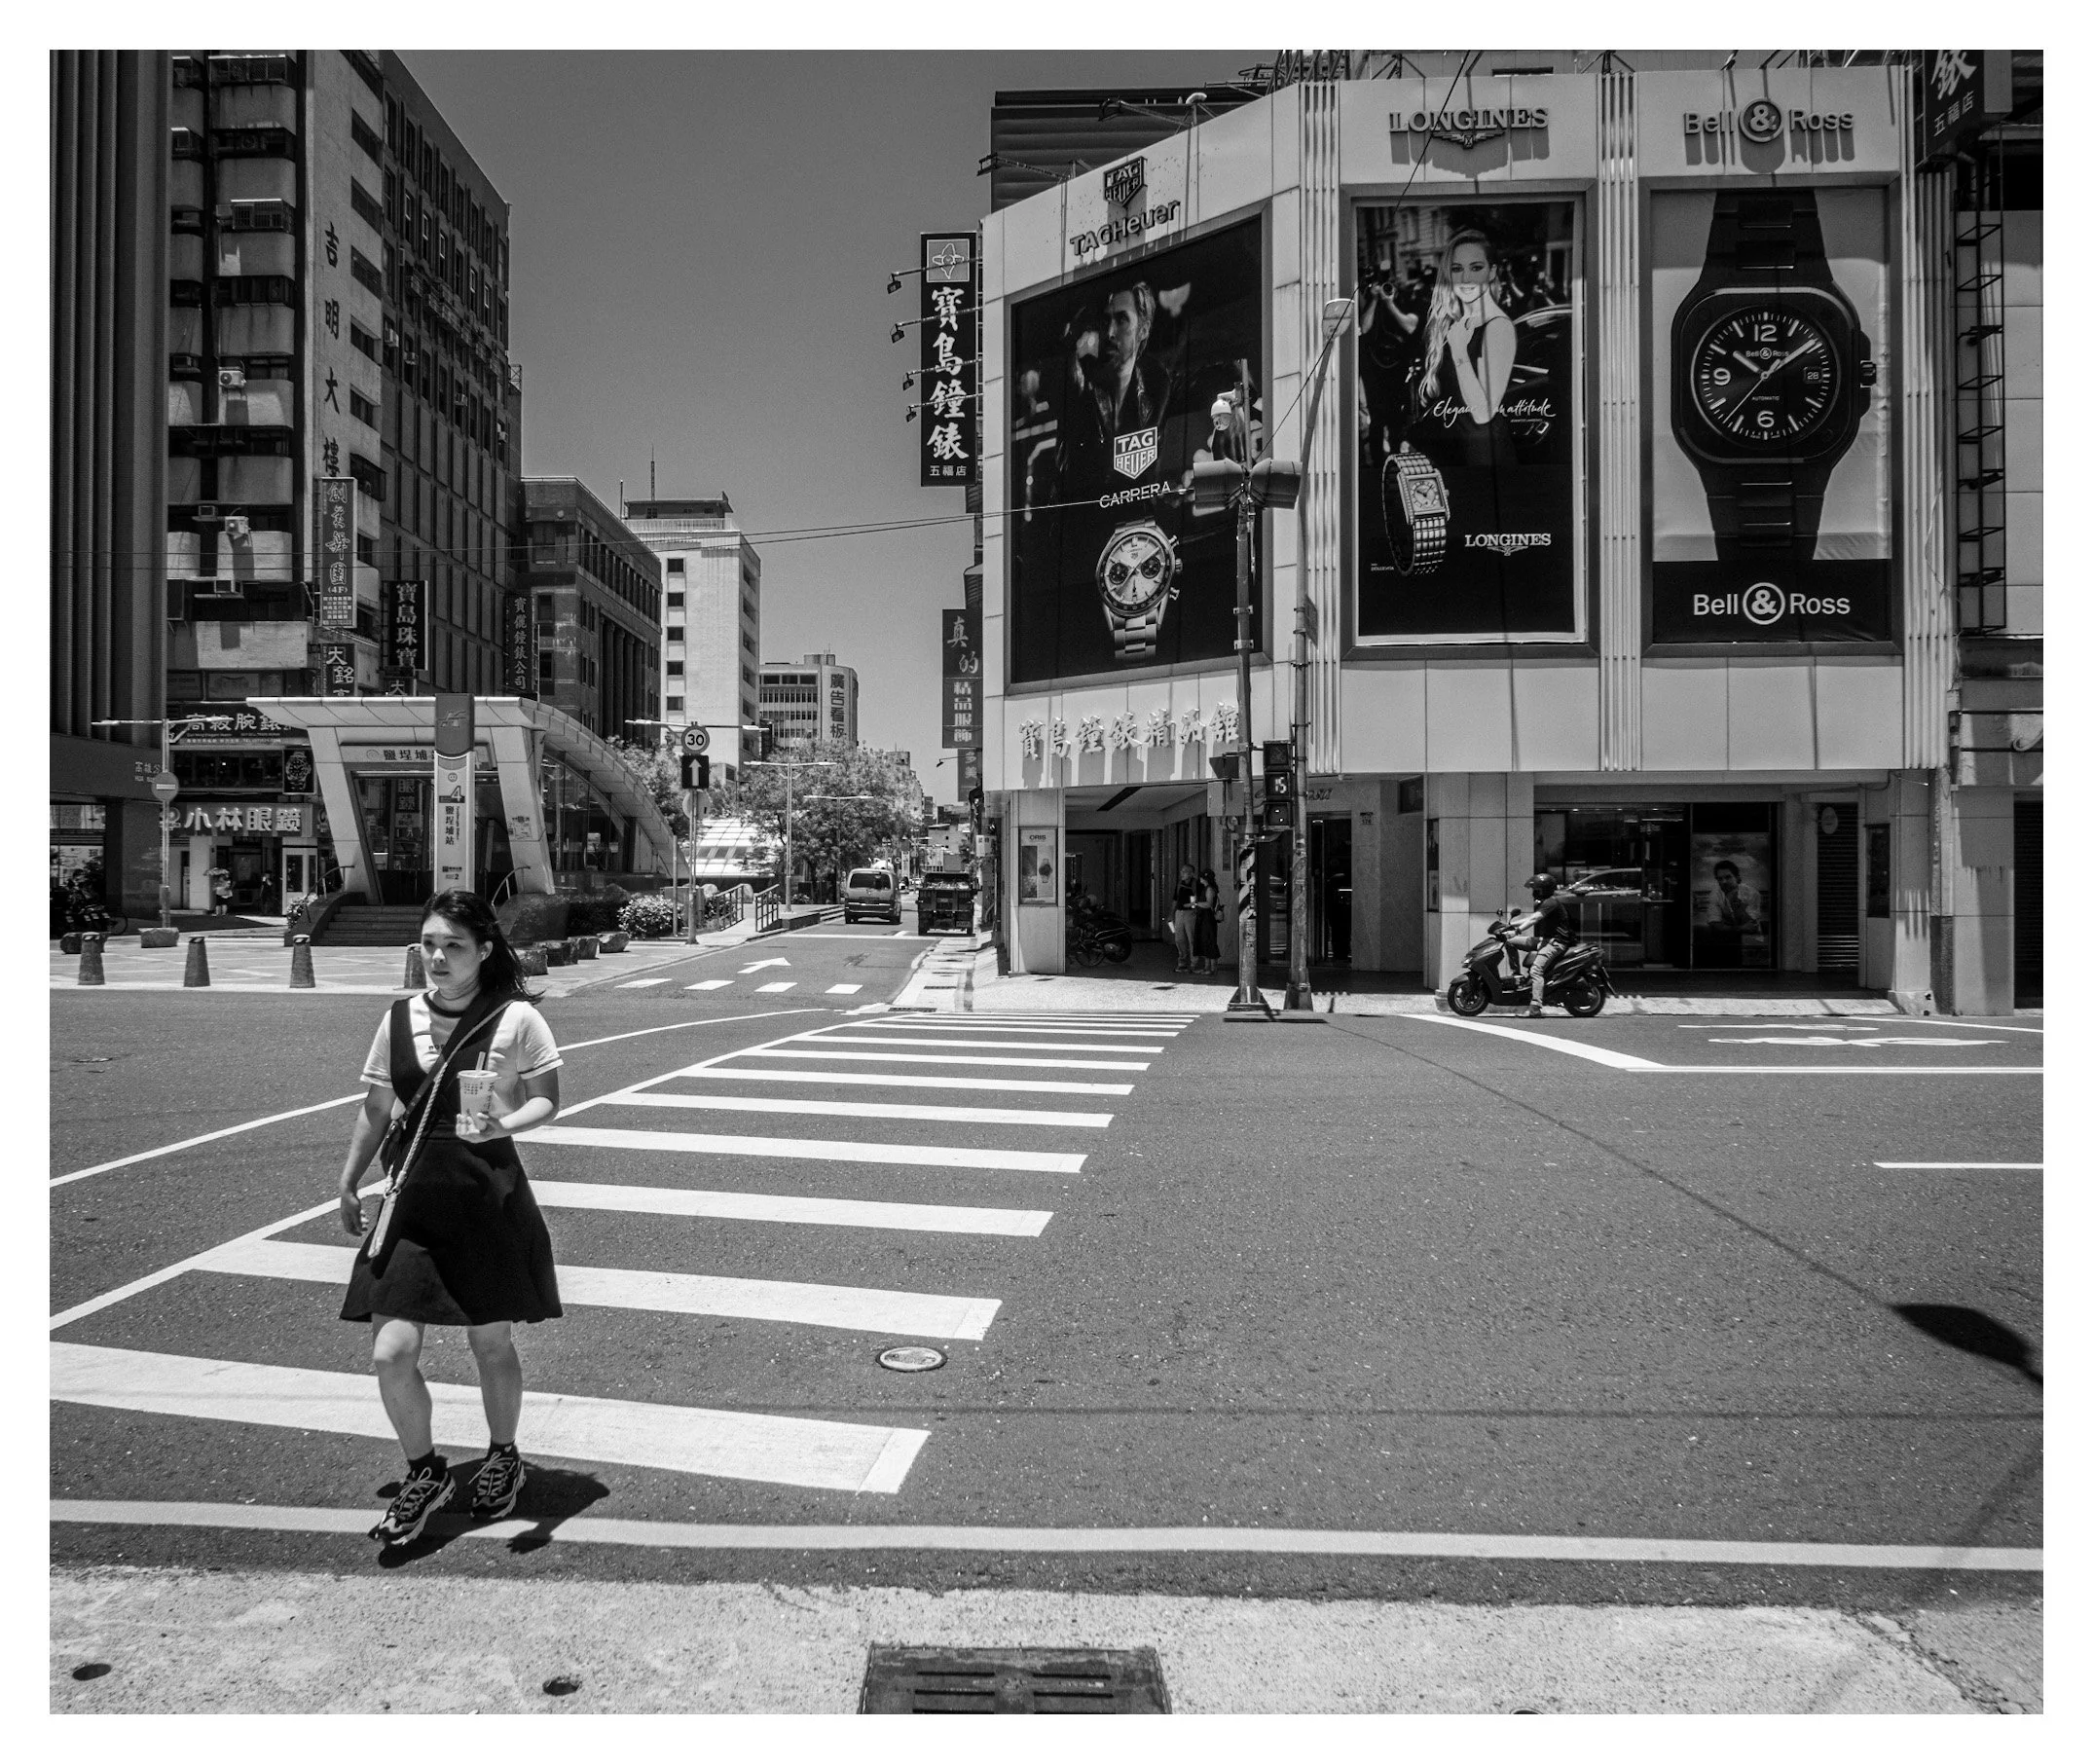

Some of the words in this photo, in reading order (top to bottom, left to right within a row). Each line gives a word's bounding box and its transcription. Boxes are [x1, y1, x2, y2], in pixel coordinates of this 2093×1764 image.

[1389, 107, 1550, 133] LONGINES
[1684, 110, 1736, 134] Bell
[1789, 109, 1854, 131] Ross
[1933, 91, 1974, 137] 五福店
[1106, 161, 1140, 185] TAG
[1106, 177, 1139, 202] HEUER
[1754, 324, 1778, 342] 12
[926, 286, 970, 460] 寶島鐘錶
[1713, 368, 1731, 386] 9
[1807, 371, 1819, 381] 28
[1757, 410, 1775, 428] 6
[1118, 430, 1154, 453] TAG
[929, 464, 968, 477] 五福店
[1116, 449, 1155, 476] HEUER
[1099, 481, 1171, 508] CARRERA
[1464, 533, 1552, 547] LONGINES
[1693, 593, 1739, 616] Bell
[1789, 593, 1852, 615] Ross
[395, 582, 418, 668] 寶島珠寶
[829, 673, 847, 738] 廣告看板
[686, 733, 706, 747] 30
[383, 749, 435, 761] 鹽埕埔
[451, 785, 462, 803] 4
[184, 806, 302, 832] 小林眼鏡
